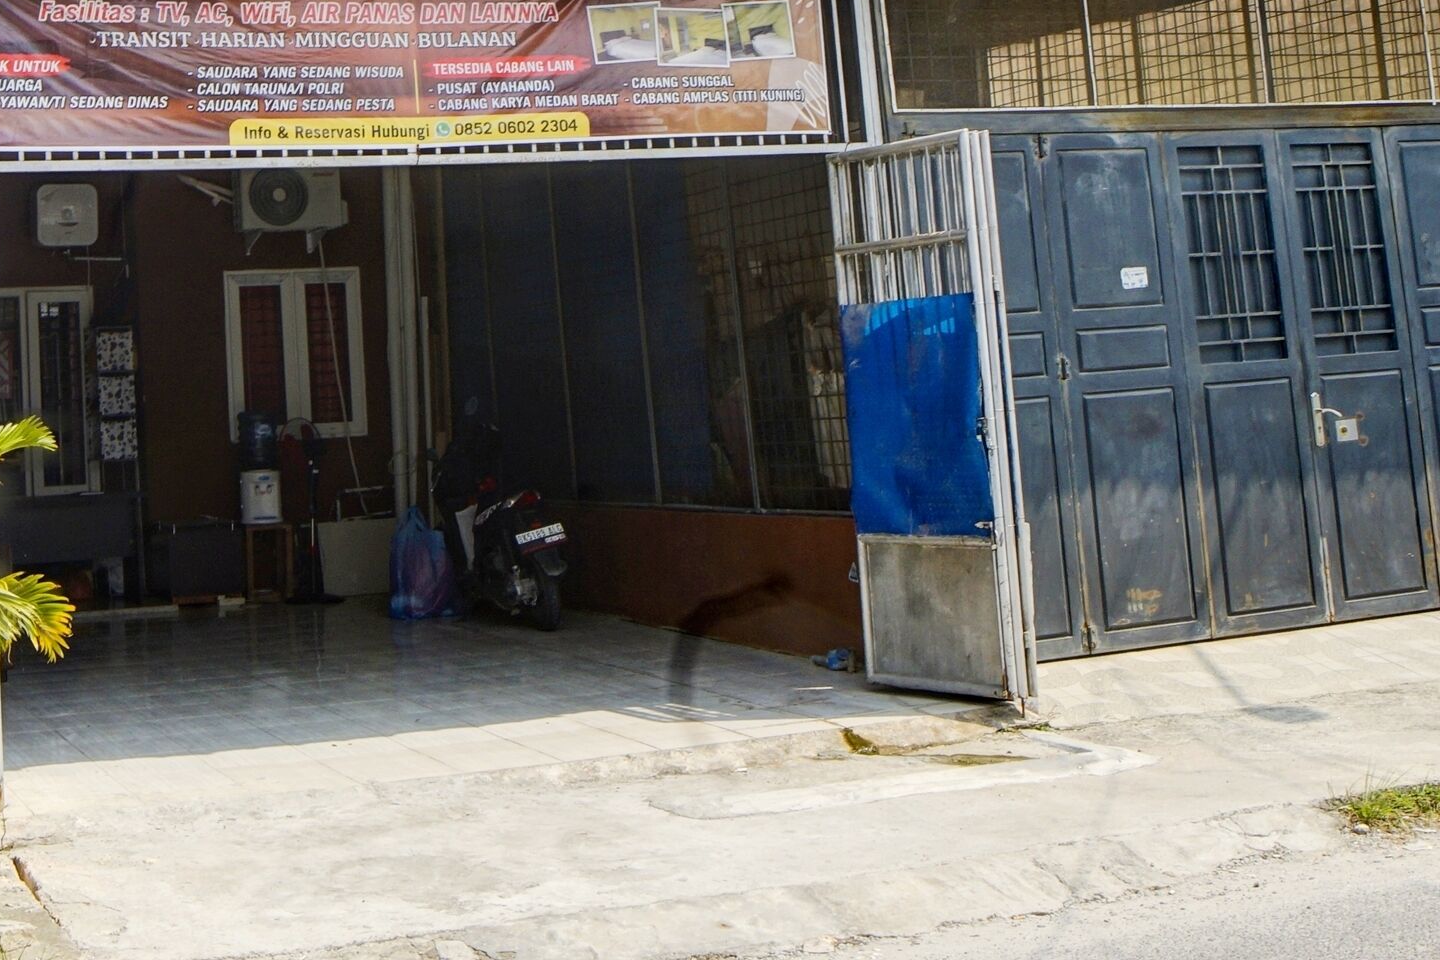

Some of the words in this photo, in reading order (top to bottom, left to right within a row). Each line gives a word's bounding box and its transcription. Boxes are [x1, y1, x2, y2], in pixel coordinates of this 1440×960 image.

[38, 0, 136, 23] Fasilitas
[155, 1, 190, 27] TV,
[195, 1, 234, 27] AC,
[240, 1, 297, 27] WiFi,
[301, 2, 340, 24] AIR
[345, 2, 415, 24] PANAS
[420, 2, 465, 24] DAN
[470, 2, 559, 24] LAINNYA
[13, 60, 61, 73] UNTUK
[197, 66, 258, 79] SAUDARA
[263, 66, 297, 79] YANG
[300, 66, 350, 79] SEDANG
[354, 66, 404, 78] WISUDA
[433, 61, 492, 75] TERSEDIA
[496, 60, 544, 74] CABANG
[547, 59, 575, 72] LAIN
[197, 82, 240, 95] CALON
[244, 82, 304, 95] TARUNA/I
[308, 82, 345, 95] POLRI
[437, 82, 477, 95] PUSAT
[481, 80, 555, 95] (AYAHANDA)
[631, 76, 679, 89] CABANG
[682, 75, 734, 88] SUNGGAL
[70, 96, 123, 109] SEDANG
[127, 96, 168, 109] DINAS
[438, 97, 488, 111] CABANG
[491, 96, 531, 109] KARYA
[535, 94, 577, 107] MEDAN
[581, 93, 619, 106] BARAT
[632, 91, 679, 105] CABANG
[683, 90, 729, 104] AMPLAS
[732, 89, 757, 103] (TITI
[760, 88, 806, 103] KUNING)
[197, 99, 259, 112] SAUDARA
[263, 99, 298, 112] YANG
[301, 98, 352, 112] SEDANG
[356, 98, 395, 111] PESTA
[244, 126, 272, 139] Info
[294, 125, 365, 139] Reservasi
[371, 124, 430, 140] Hubungi
[454, 122, 492, 135] 0852
[498, 120, 535, 134] 0602
[540, 119, 578, 133] 2304
